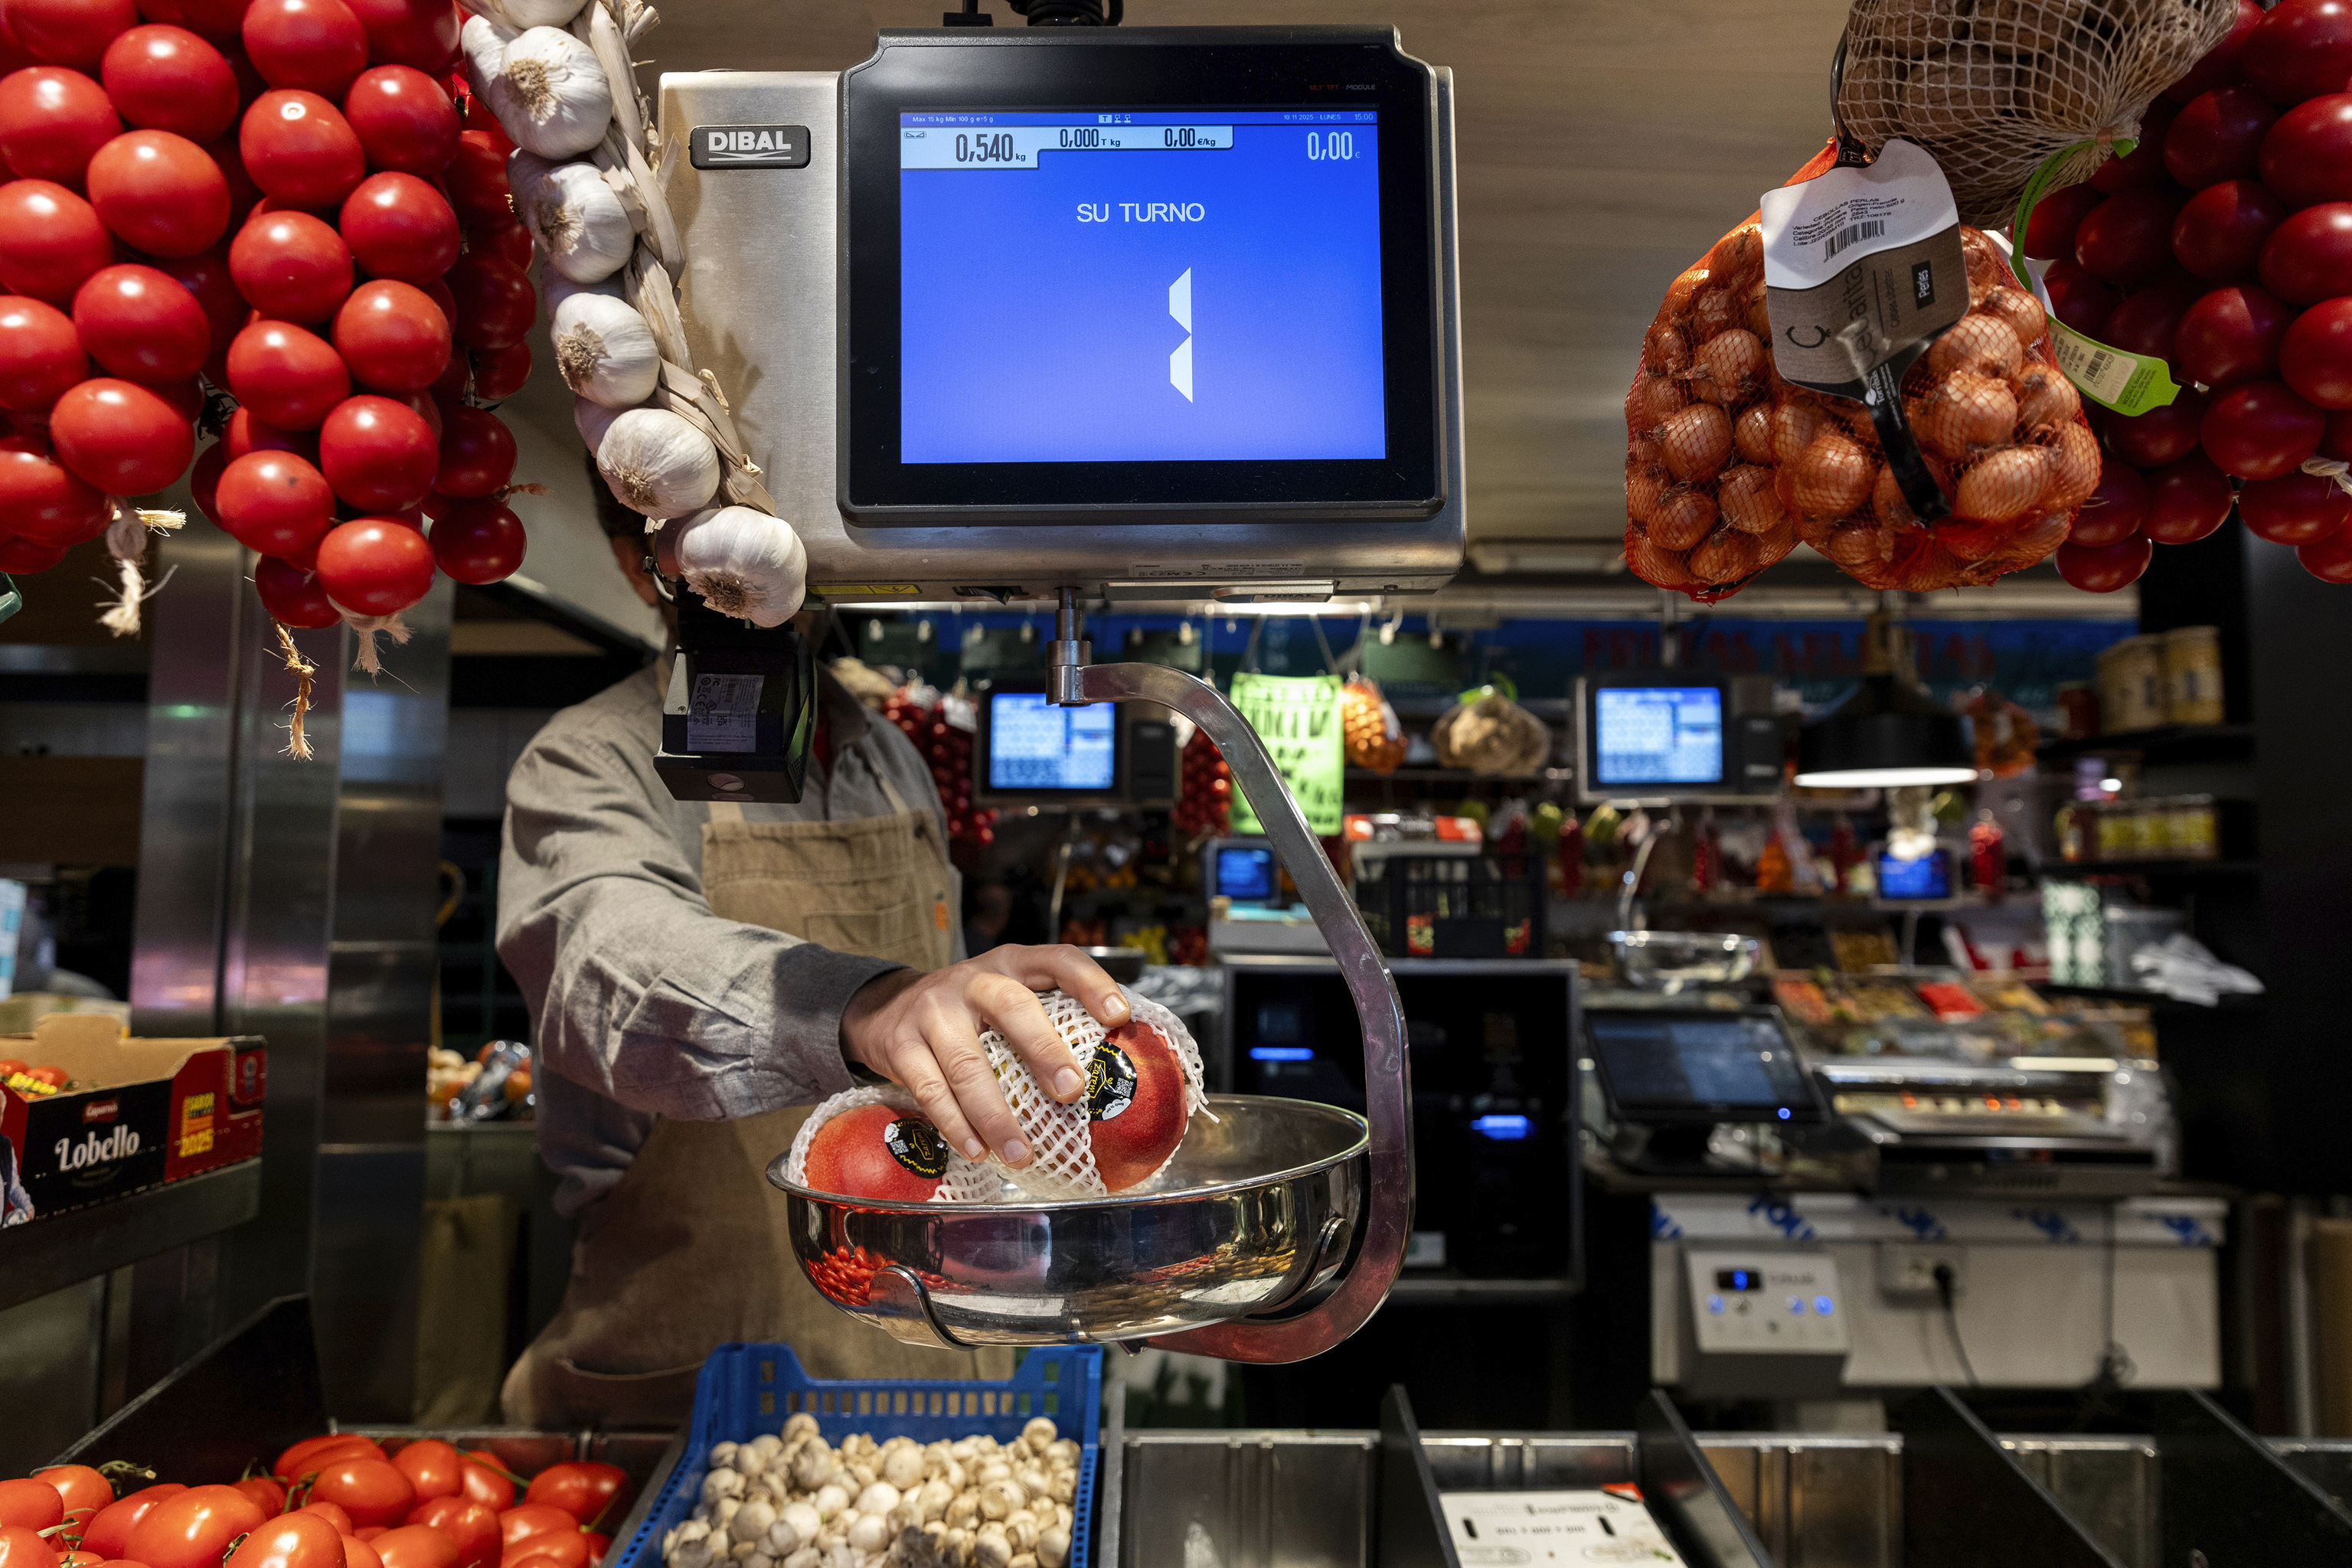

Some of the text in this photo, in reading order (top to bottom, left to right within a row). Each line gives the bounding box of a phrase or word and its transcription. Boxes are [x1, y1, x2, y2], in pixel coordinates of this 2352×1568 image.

[708, 130, 792, 152] DIBAL
[956, 133, 1026, 162] 0,540 kg
[1060, 128, 1099, 148] 0,000
[1110, 138, 1121, 147] kg
[1165, 128, 1216, 147] 0,00 €/kg
[1307, 131, 1353, 161] 0,00
[1076, 202, 1206, 223] SU TURNO
[1813, 201, 1849, 222] CEBOLLAS
[1917, 270, 1930, 299] Perles
[1087, 1063, 1101, 1093] zarem
[54, 1124, 140, 1172] Lobello
[916, 1132, 930, 1156] zarem
